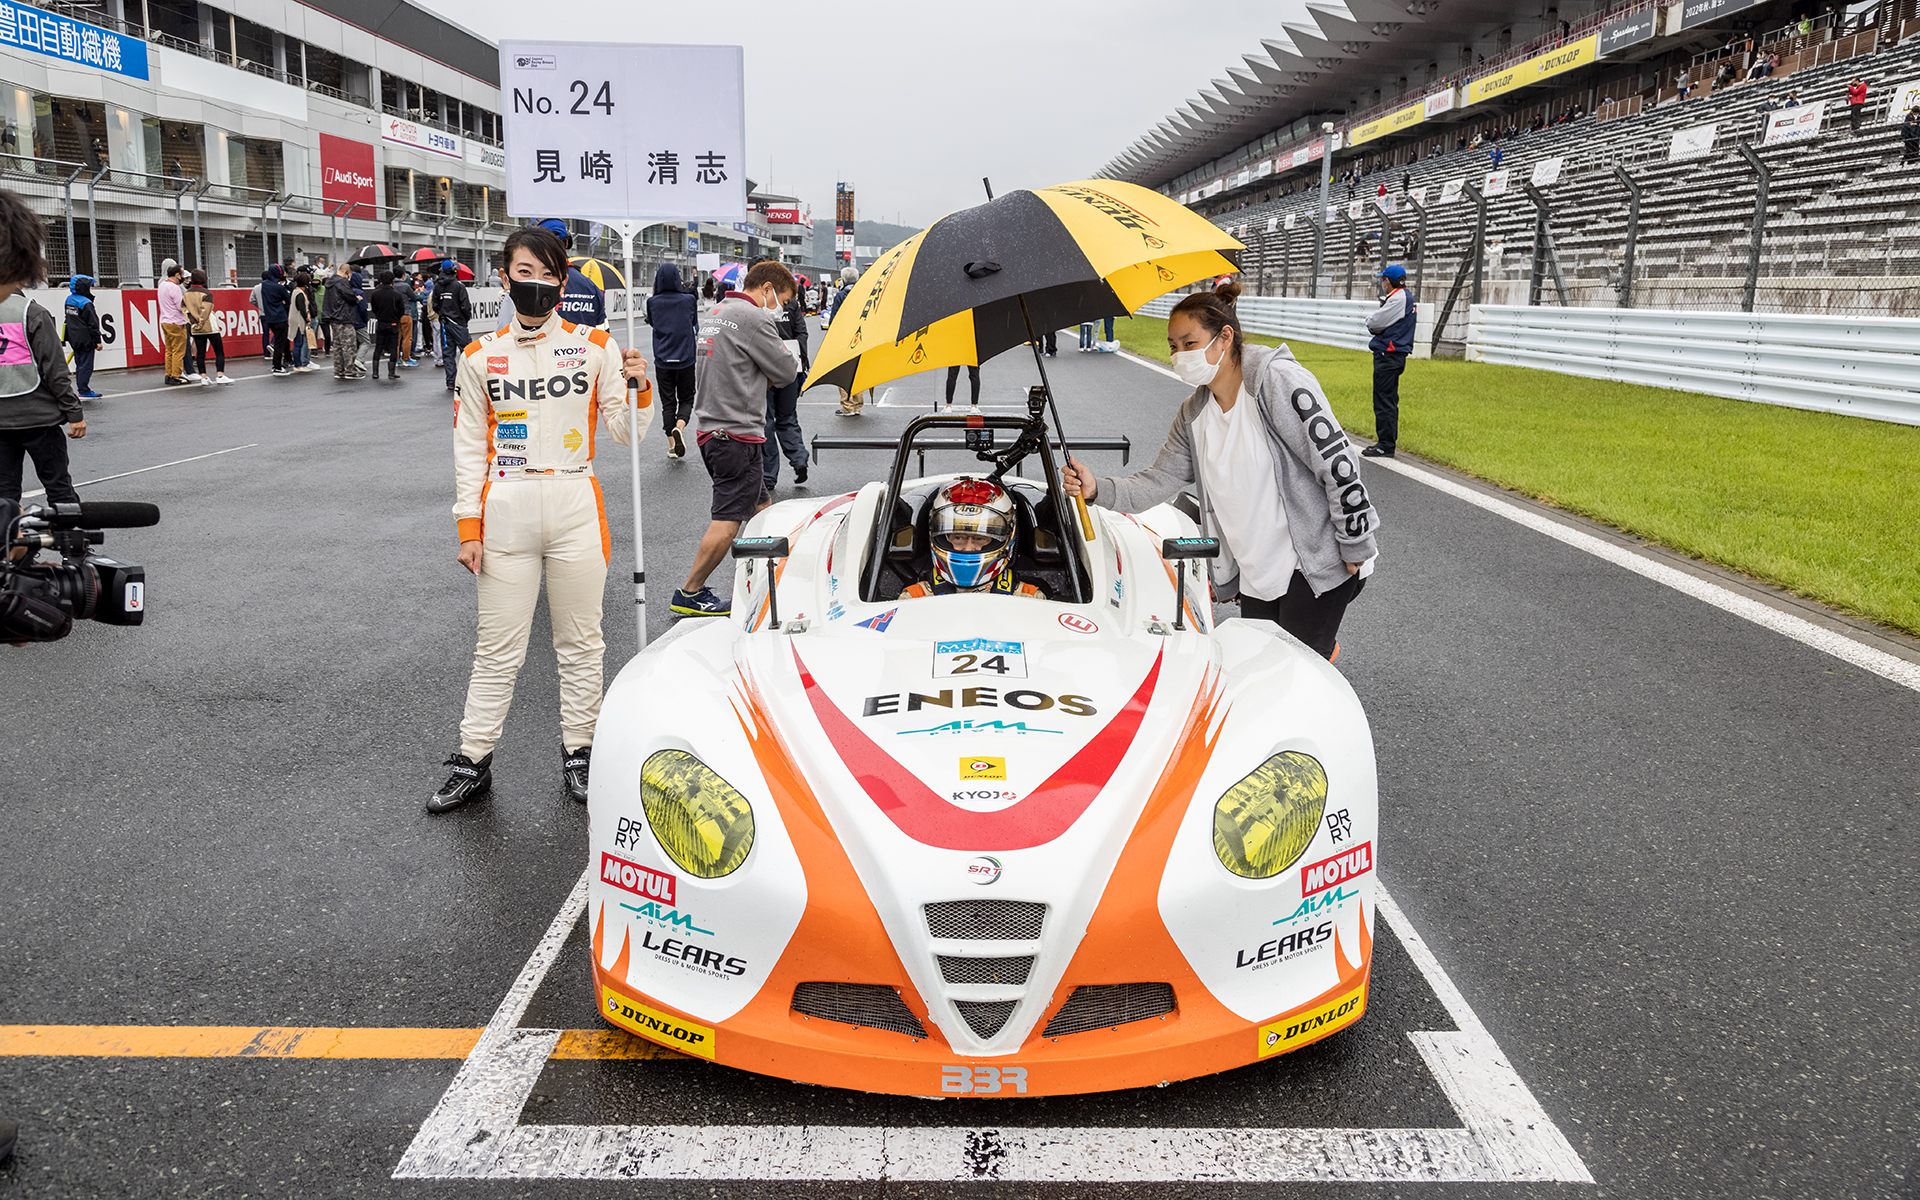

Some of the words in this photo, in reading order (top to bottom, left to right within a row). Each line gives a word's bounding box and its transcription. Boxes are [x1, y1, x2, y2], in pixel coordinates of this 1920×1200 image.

[1543, 48, 1580, 71] DUNLOP
[1484, 74, 1513, 93] DUNLOP
[513, 87, 560, 114] No.
[569, 80, 615, 115] 24
[399, 121, 418, 135] TOYOTA
[1395, 110, 1416, 125] DUNLOP
[1361, 124, 1379, 138] DUNLOP
[334, 169, 352, 183] Audi
[352, 173, 374, 188] Sport
[556, 359, 583, 369] SRT
[486, 371, 589, 401] ENEOS
[1291, 387, 1371, 537] adidas
[957, 505, 981, 514] Arai
[1063, 615, 1093, 632] E
[951, 654, 1010, 674] 24
[862, 687, 1098, 717] ENEOS
[617, 816, 642, 837] DR
[1326, 808, 1351, 830] DR
[614, 832, 640, 851] RY
[1330, 822, 1352, 844] RY
[603, 858, 672, 901] MOTUL
[968, 865, 1003, 875] SRT
[1305, 847, 1370, 893] MOTUL
[642, 931, 748, 976] LEARS
[1236, 921, 1332, 968] LEARS
[654, 954, 671, 963] DRESS
[686, 964, 707, 975] MOTOR
[708, 969, 730, 981] SPORTS
[1251, 962, 1270, 971] DRESS
[1284, 950, 1303, 961] MOTOR
[1304, 944, 1323, 956] SPORTS
[620, 1005, 705, 1044] DUNLOP
[1283, 996, 1360, 1040] DUNLOP
